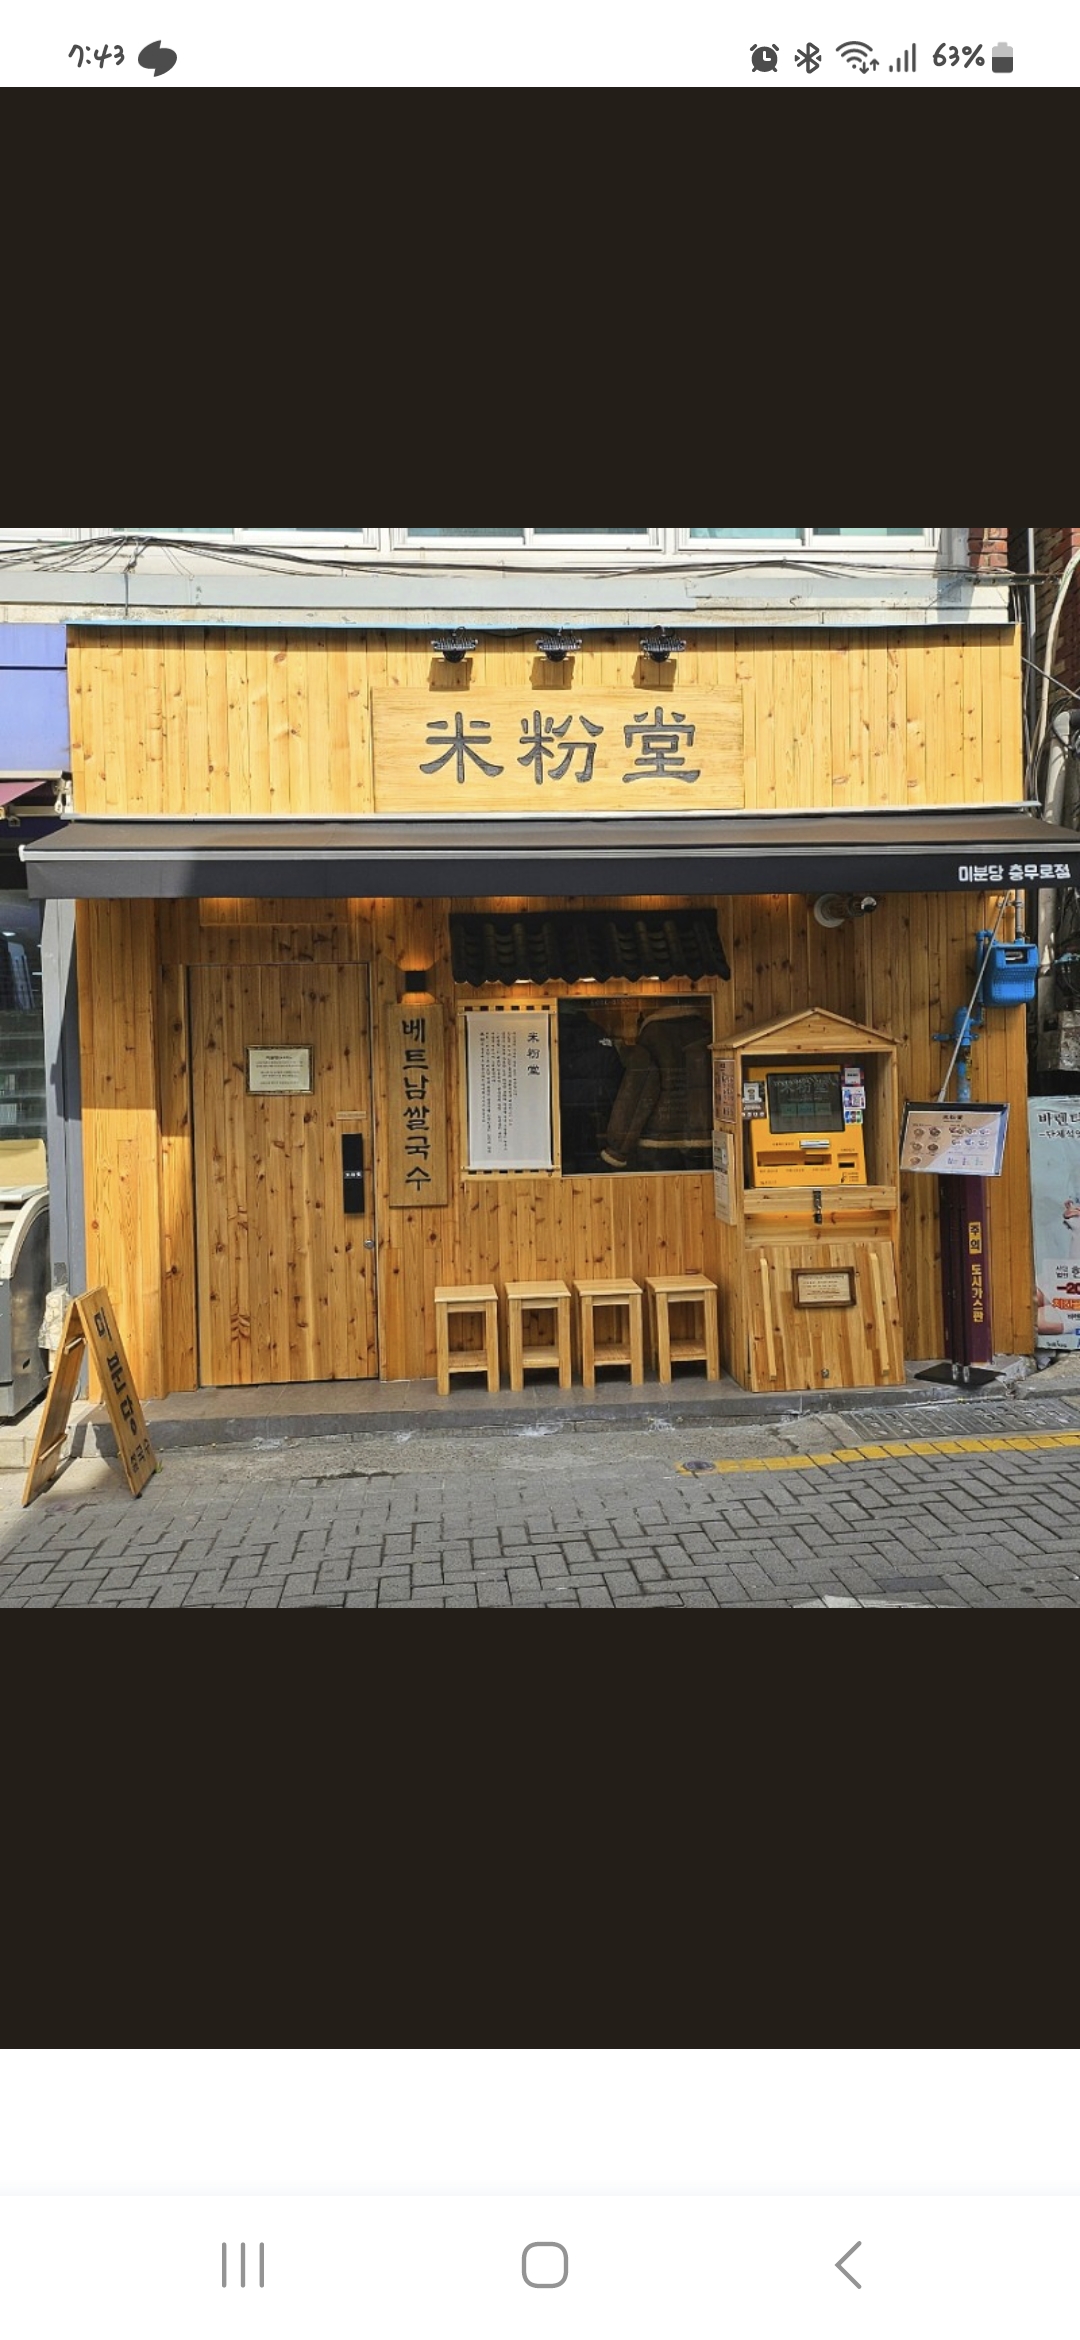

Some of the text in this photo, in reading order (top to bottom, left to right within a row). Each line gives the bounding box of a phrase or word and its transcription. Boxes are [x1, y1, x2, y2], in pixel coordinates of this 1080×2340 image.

[419, 705, 701, 786] 米粉堂
[958, 863, 1071, 883] 미분당 충무로점
[526, 1032, 541, 1076] 米粉堂
[401, 1017, 432, 1192] 베트남쌀국수
[969, 1223, 981, 1252] 주의
[94, 1307, 138, 1437] 미분당
